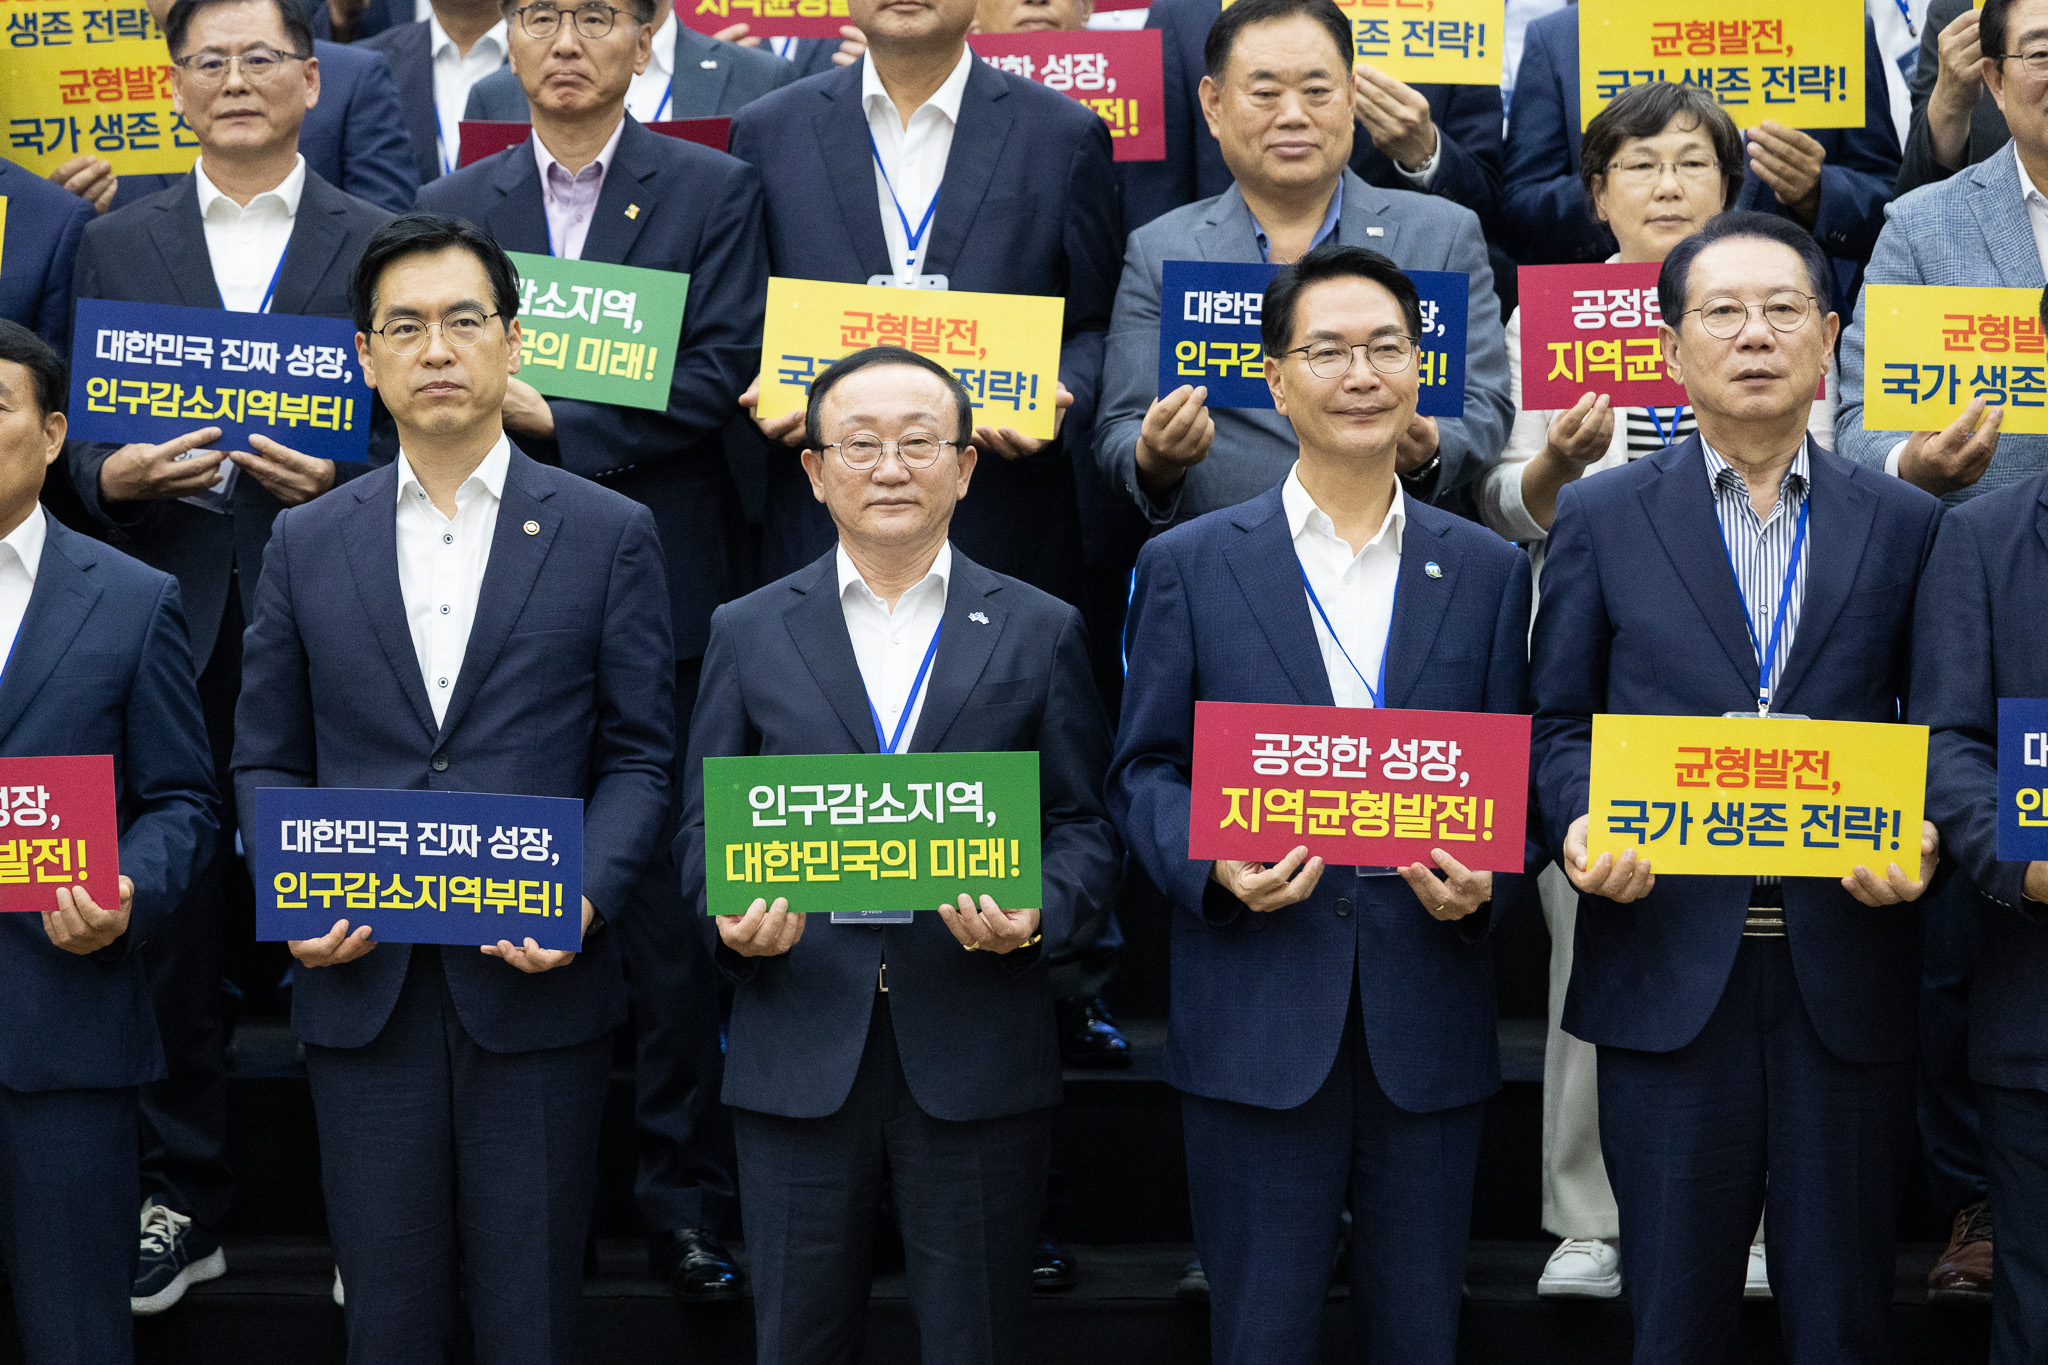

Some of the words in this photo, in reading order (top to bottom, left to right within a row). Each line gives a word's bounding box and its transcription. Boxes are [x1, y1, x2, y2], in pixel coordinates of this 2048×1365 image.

[6, 12, 73, 47] 생존
[1348, 19, 1390, 57] 존
[1401, 20, 1486, 58] 전략!
[1651, 20, 1794, 58] 균형발전,
[1040, 53, 1117, 93] 성장,
[1761, 66, 1847, 104] 전략!
[9, 116, 81, 156] 국가
[89, 112, 161, 152] 생존
[1079, 98, 1139, 138] 전!
[96, 329, 214, 369] 대한민국
[220, 338, 281, 374] 진짜
[285, 344, 353, 383] 성장,
[840, 310, 987, 361] 균형발전,
[576, 337, 658, 381] 미래!
[1547, 338, 1673, 383] 지역균
[86, 377, 353, 431] 인구감소지역부터!
[951, 368, 1038, 411] 전략!
[1882, 363, 1961, 405] 국가
[1970, 365, 2047, 407] 생존
[1252, 733, 1372, 779] 공정한
[1379, 738, 1470, 787] 성장,
[1674, 746, 1841, 795] 균형발전,
[748, 781, 997, 829] 인구감소지역,
[1220, 787, 1494, 842] 지역균형발전!
[1607, 799, 1693, 846] 국가
[1703, 802, 1788, 848] 생존
[1800, 804, 1901, 851] 전략!
[281, 818, 409, 856] 대한민국
[417, 822, 482, 860] 진짜
[487, 825, 560, 866] 성장,
[725, 838, 917, 883] 대한민국의
[930, 837, 1021, 878] 미래!
[273, 872, 564, 918] 인구감소지역부터!
